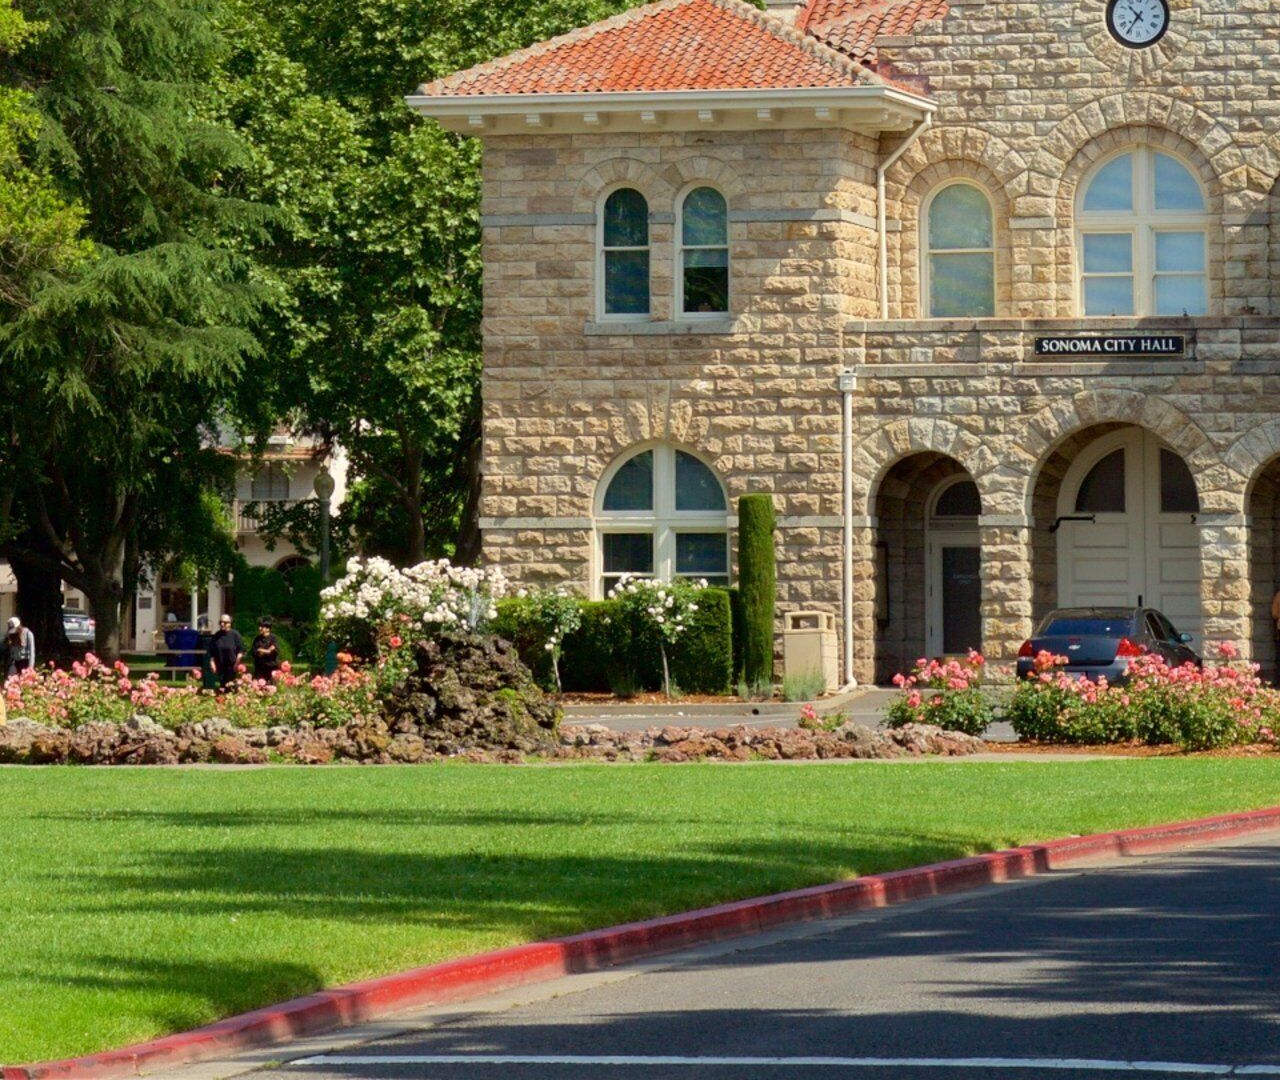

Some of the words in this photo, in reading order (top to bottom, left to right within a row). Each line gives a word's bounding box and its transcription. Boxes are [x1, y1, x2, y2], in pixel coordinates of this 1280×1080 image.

[1042, 339, 1101, 352] SONOMA
[1104, 339, 1137, 352] CITY
[1141, 338, 1176, 351] HALL
